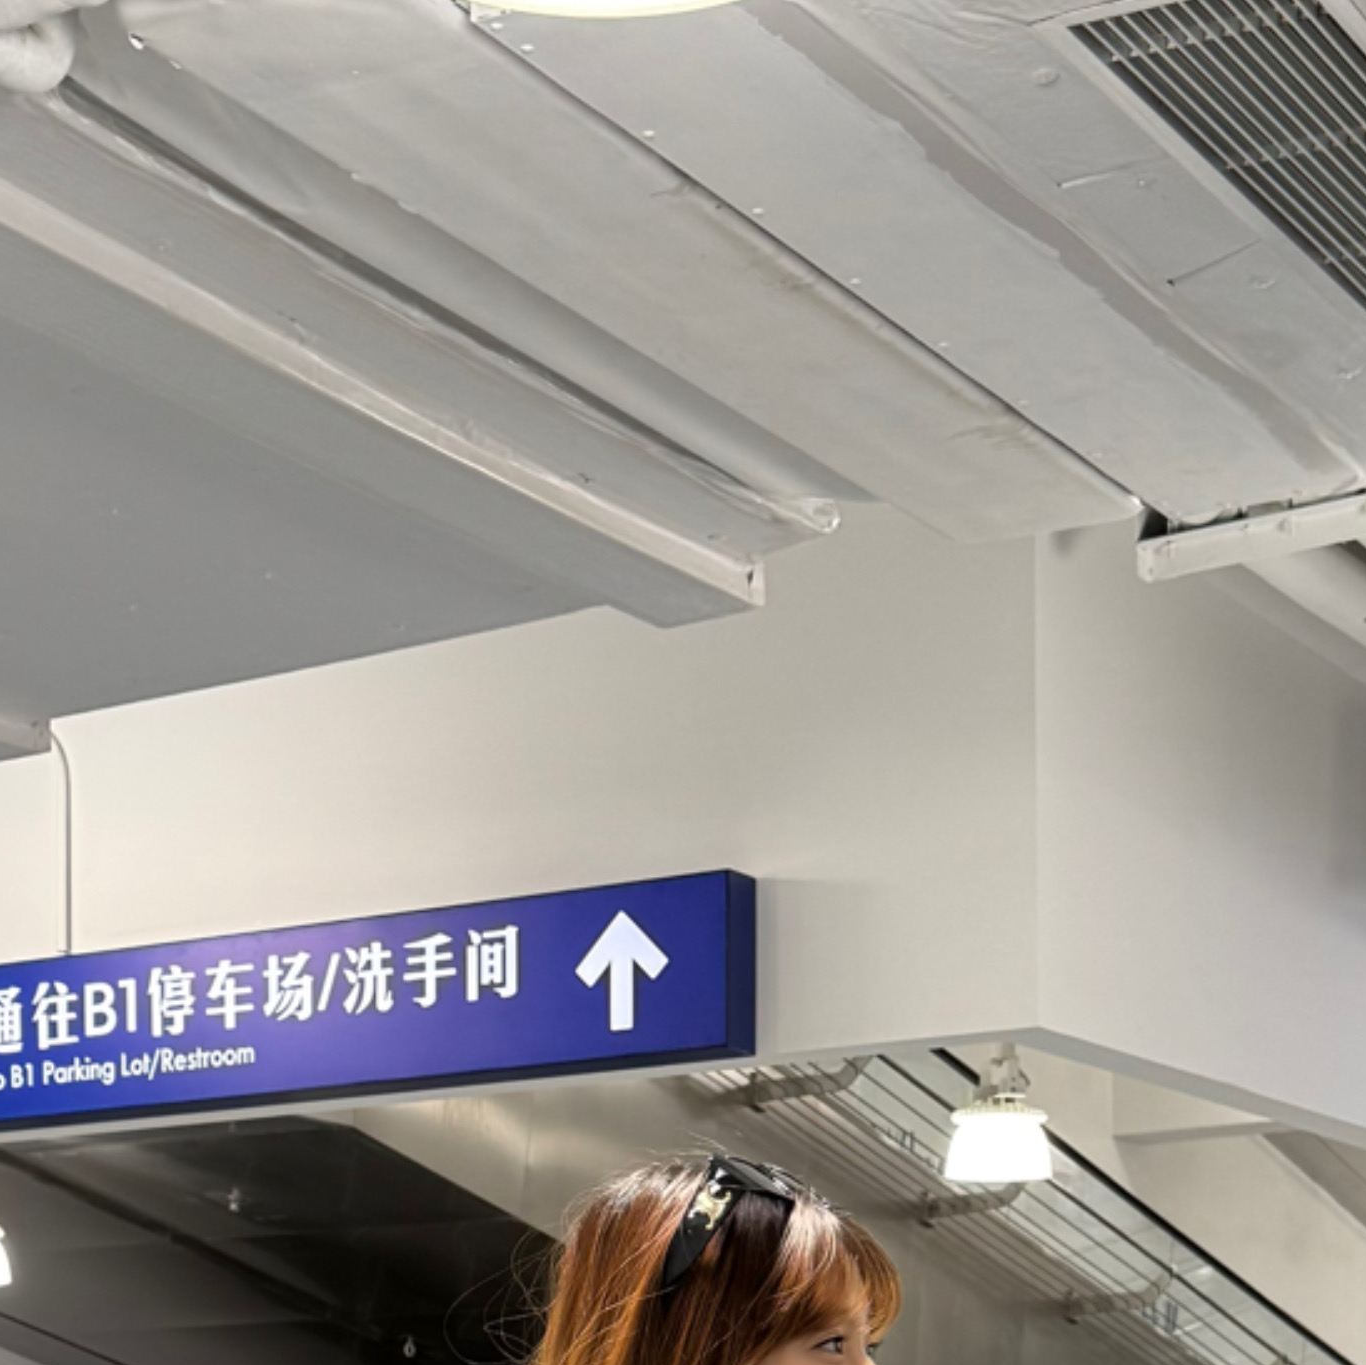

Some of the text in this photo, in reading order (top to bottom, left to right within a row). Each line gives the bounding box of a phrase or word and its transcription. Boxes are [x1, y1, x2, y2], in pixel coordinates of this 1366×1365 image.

[10, 1062, 34, 1089] B1
[42, 1056, 114, 1085] Parking
[121, 1046, 256, 1080] Lot/Restroom
